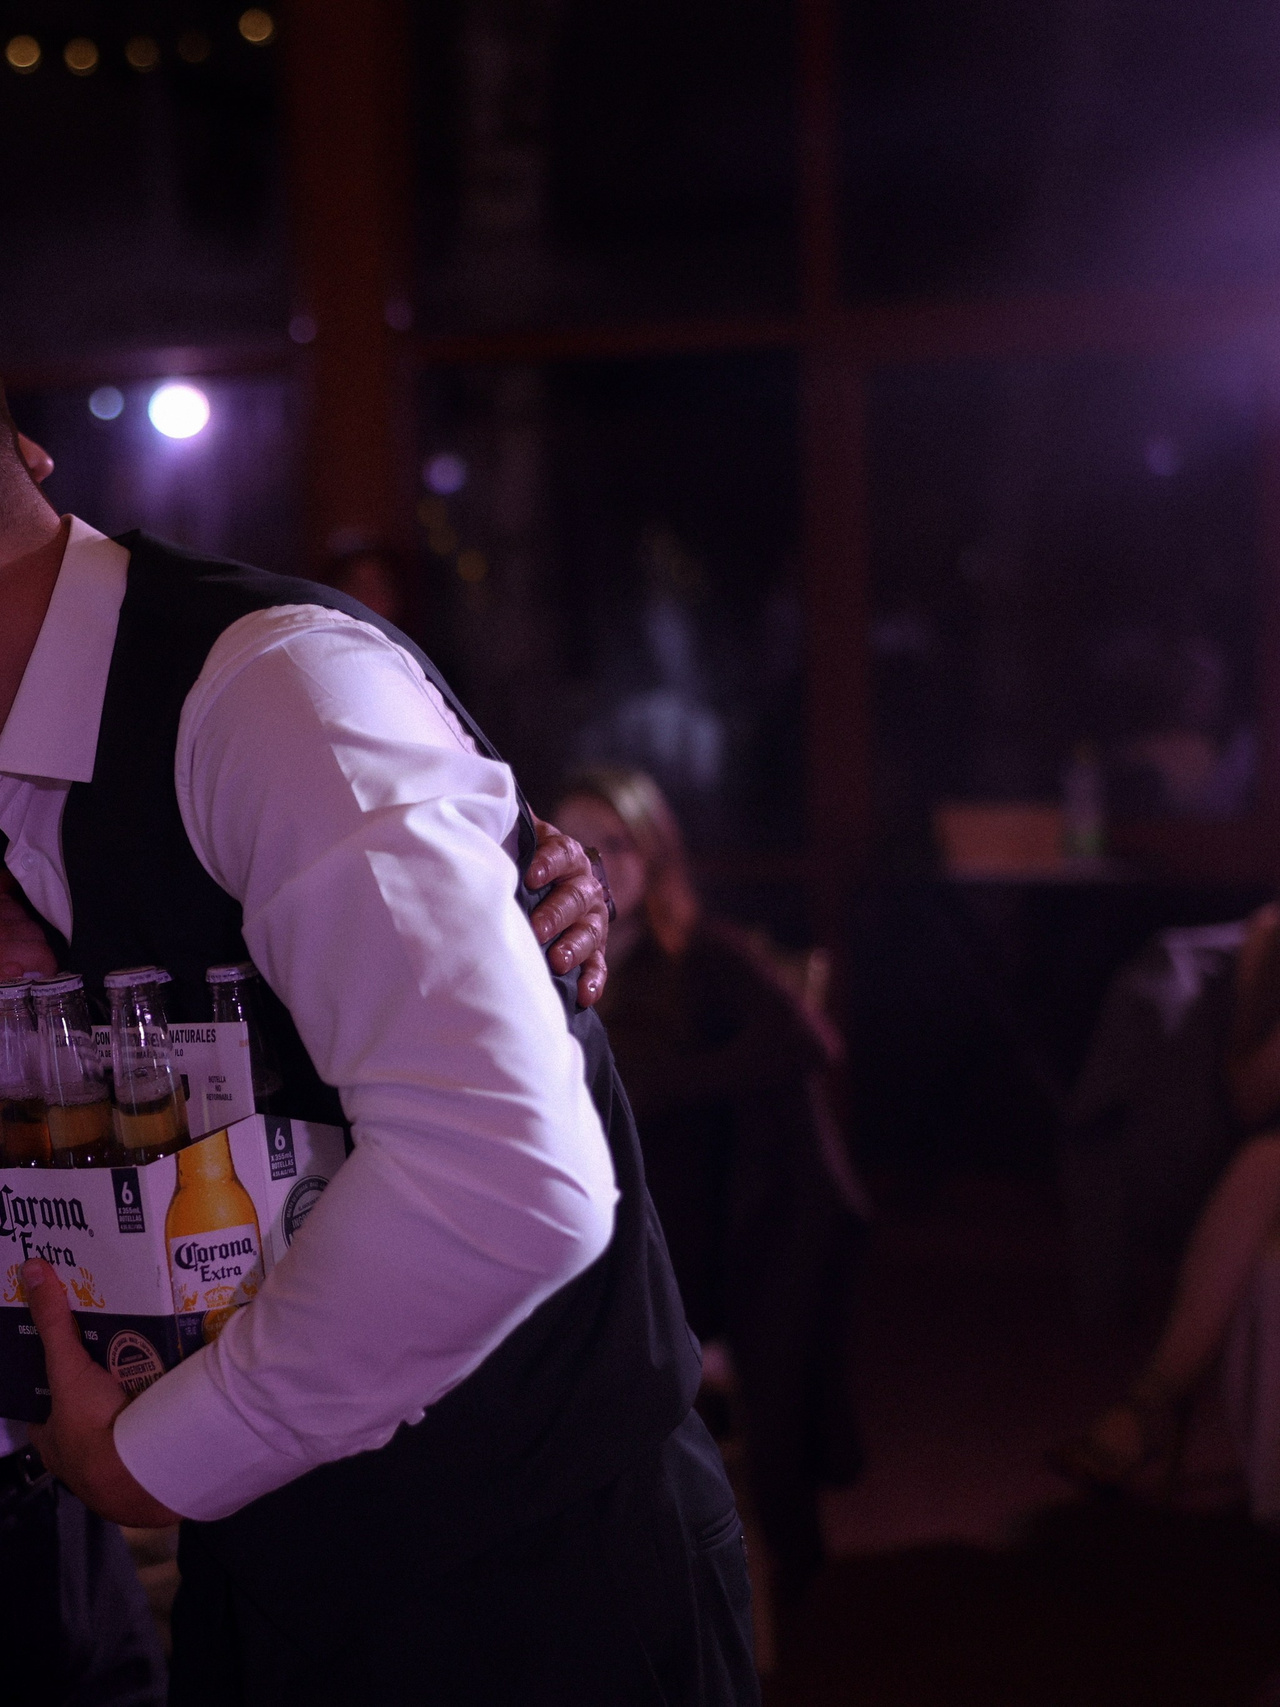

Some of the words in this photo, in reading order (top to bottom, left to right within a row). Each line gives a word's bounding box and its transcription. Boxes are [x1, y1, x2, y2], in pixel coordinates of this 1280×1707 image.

[95, 1031, 111, 1046] CON
[169, 1029, 216, 1044] NATURALES
[274, 1127, 286, 1151] 6
[121, 1181, 134, 1205] 6
[19, 1231, 76, 1268] Extra
[174, 1237, 253, 1272] Corona
[200, 1265, 242, 1282] Extra
[18, 1325, 39, 1335] DESDE
[84, 1330, 99, 1341] 1925
